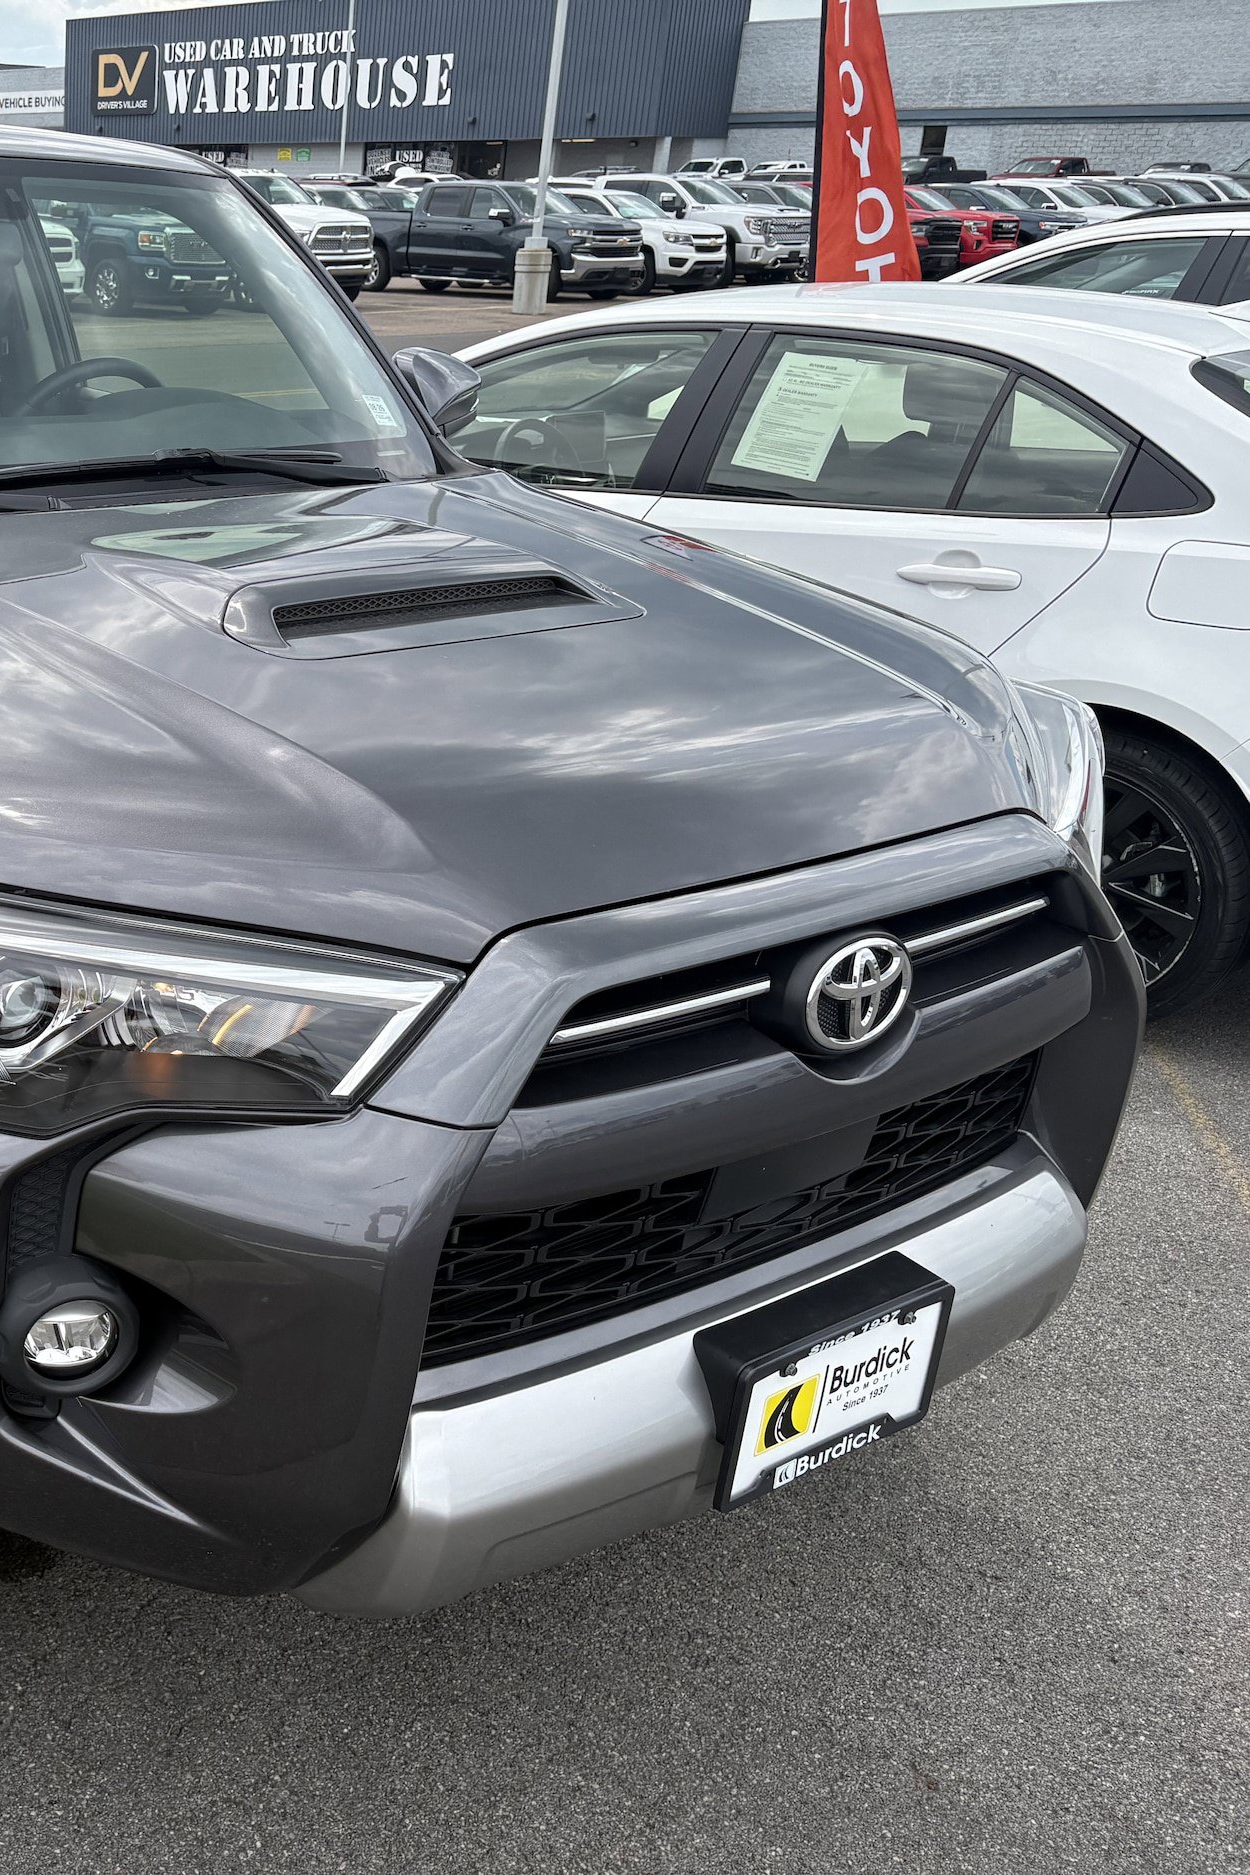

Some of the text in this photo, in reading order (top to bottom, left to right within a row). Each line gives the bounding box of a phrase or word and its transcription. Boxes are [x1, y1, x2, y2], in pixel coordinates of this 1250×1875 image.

[164, 30, 356, 63] USED CAR AND TRUCK
[98, 51, 149, 97] DV
[162, 53, 455, 115] WAREHOUSE
[0, 98, 33, 109] VEHICLE
[123, 100, 148, 109] VILLAGE
[395, 150, 424, 162] USED
[808, 1309, 901, 1357] Since 1937
[827, 1363, 910, 1407] AUTOMOTIVE
[829, 1337, 915, 1395] Burdick
[842, 1383, 889, 1412] Since 1937
[796, 1423, 882, 1478] Burdick
